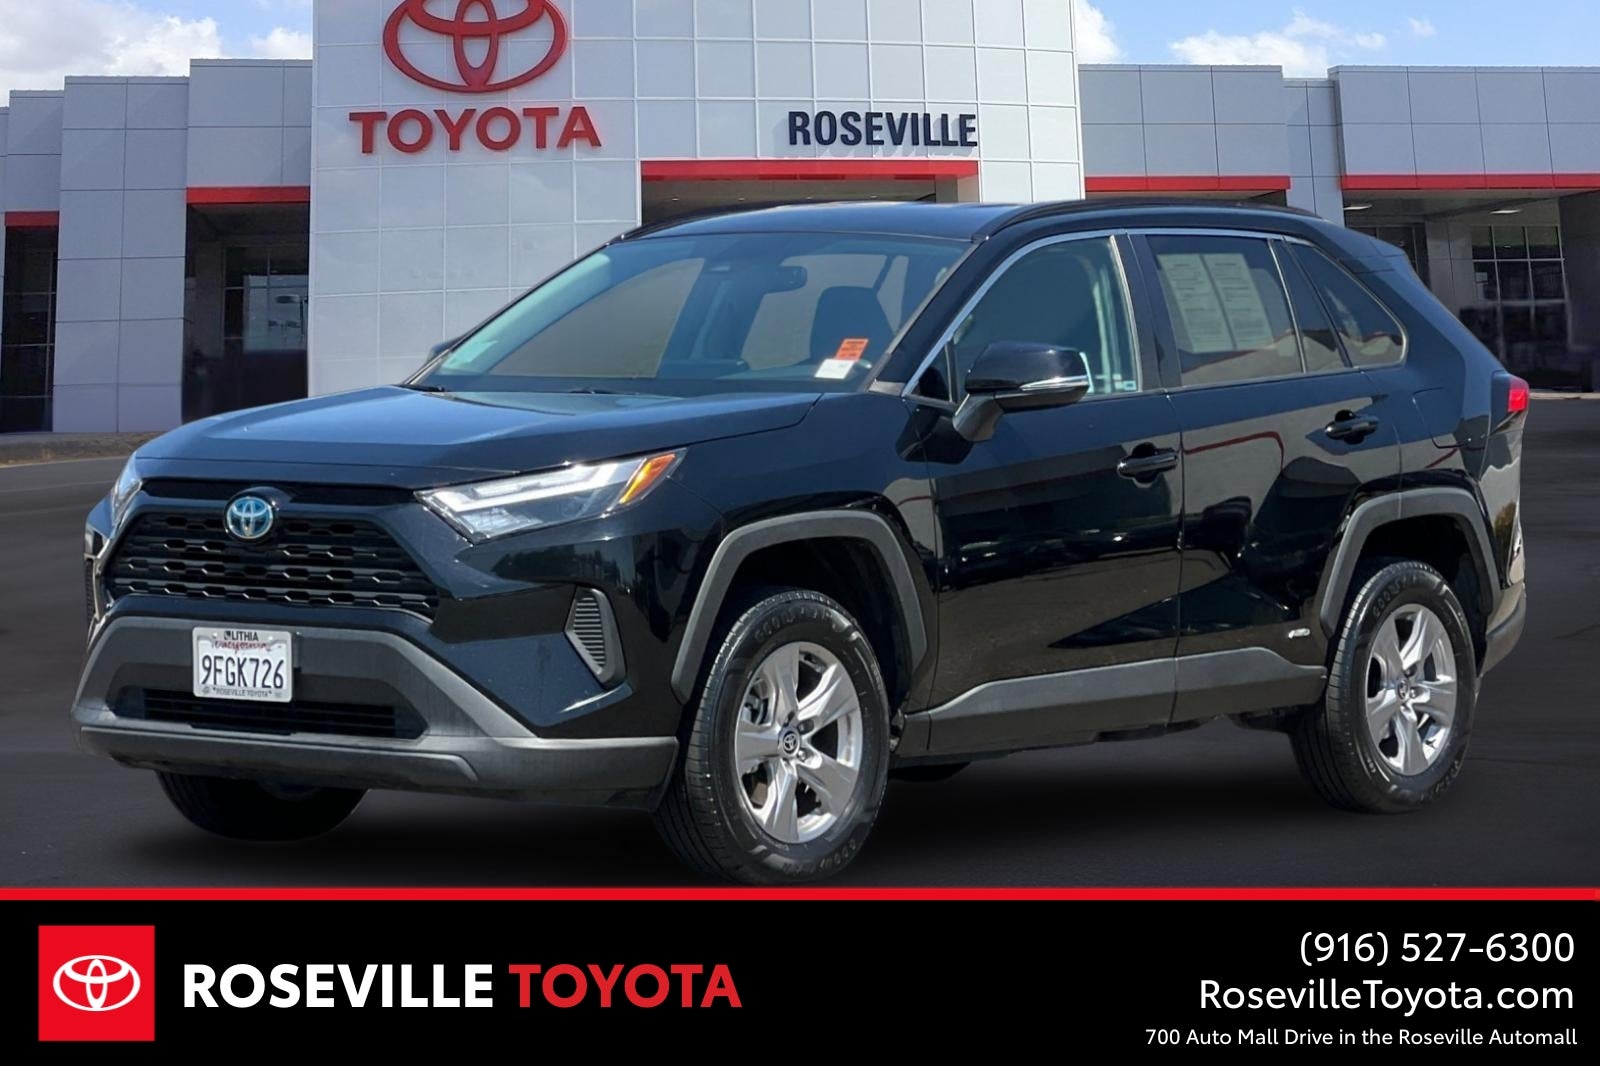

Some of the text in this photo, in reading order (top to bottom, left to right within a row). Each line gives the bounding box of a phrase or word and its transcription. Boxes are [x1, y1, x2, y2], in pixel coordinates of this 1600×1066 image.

[348, 106, 602, 154] TOYOTA
[788, 110, 978, 147] ROSEVILLE
[231, 631, 259, 641] LITHIA
[201, 655, 284, 689] 9FGK726
